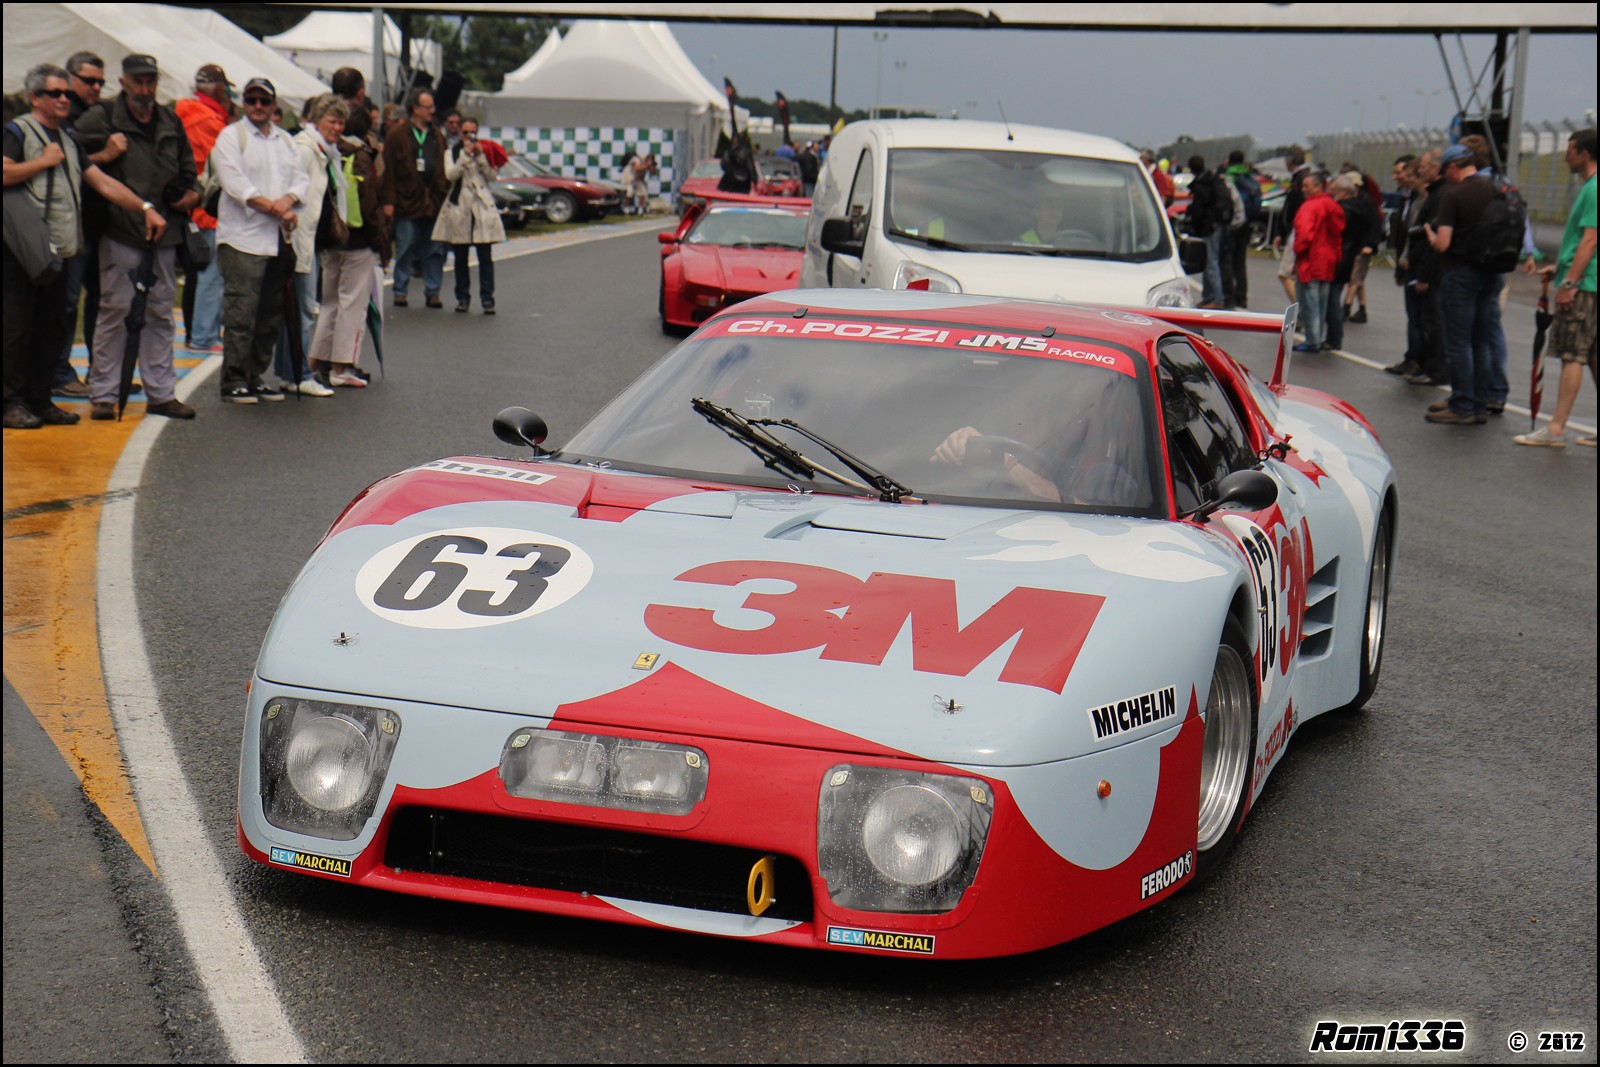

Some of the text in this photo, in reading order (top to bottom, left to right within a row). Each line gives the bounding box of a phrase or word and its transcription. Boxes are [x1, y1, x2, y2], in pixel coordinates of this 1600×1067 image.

[728, 320, 795, 334] Ch.
[801, 322, 950, 343] POZZI
[1048, 347, 1116, 366] RACING
[373, 534, 571, 617] 63
[643, 560, 1107, 695] 3M
[1241, 525, 1277, 682] 63
[1091, 687, 1176, 739] MICHELIN
[295, 853, 348, 874] MARCHAL
[1141, 856, 1184, 900] FERODO
[864, 932, 931, 951] MARCHAL
